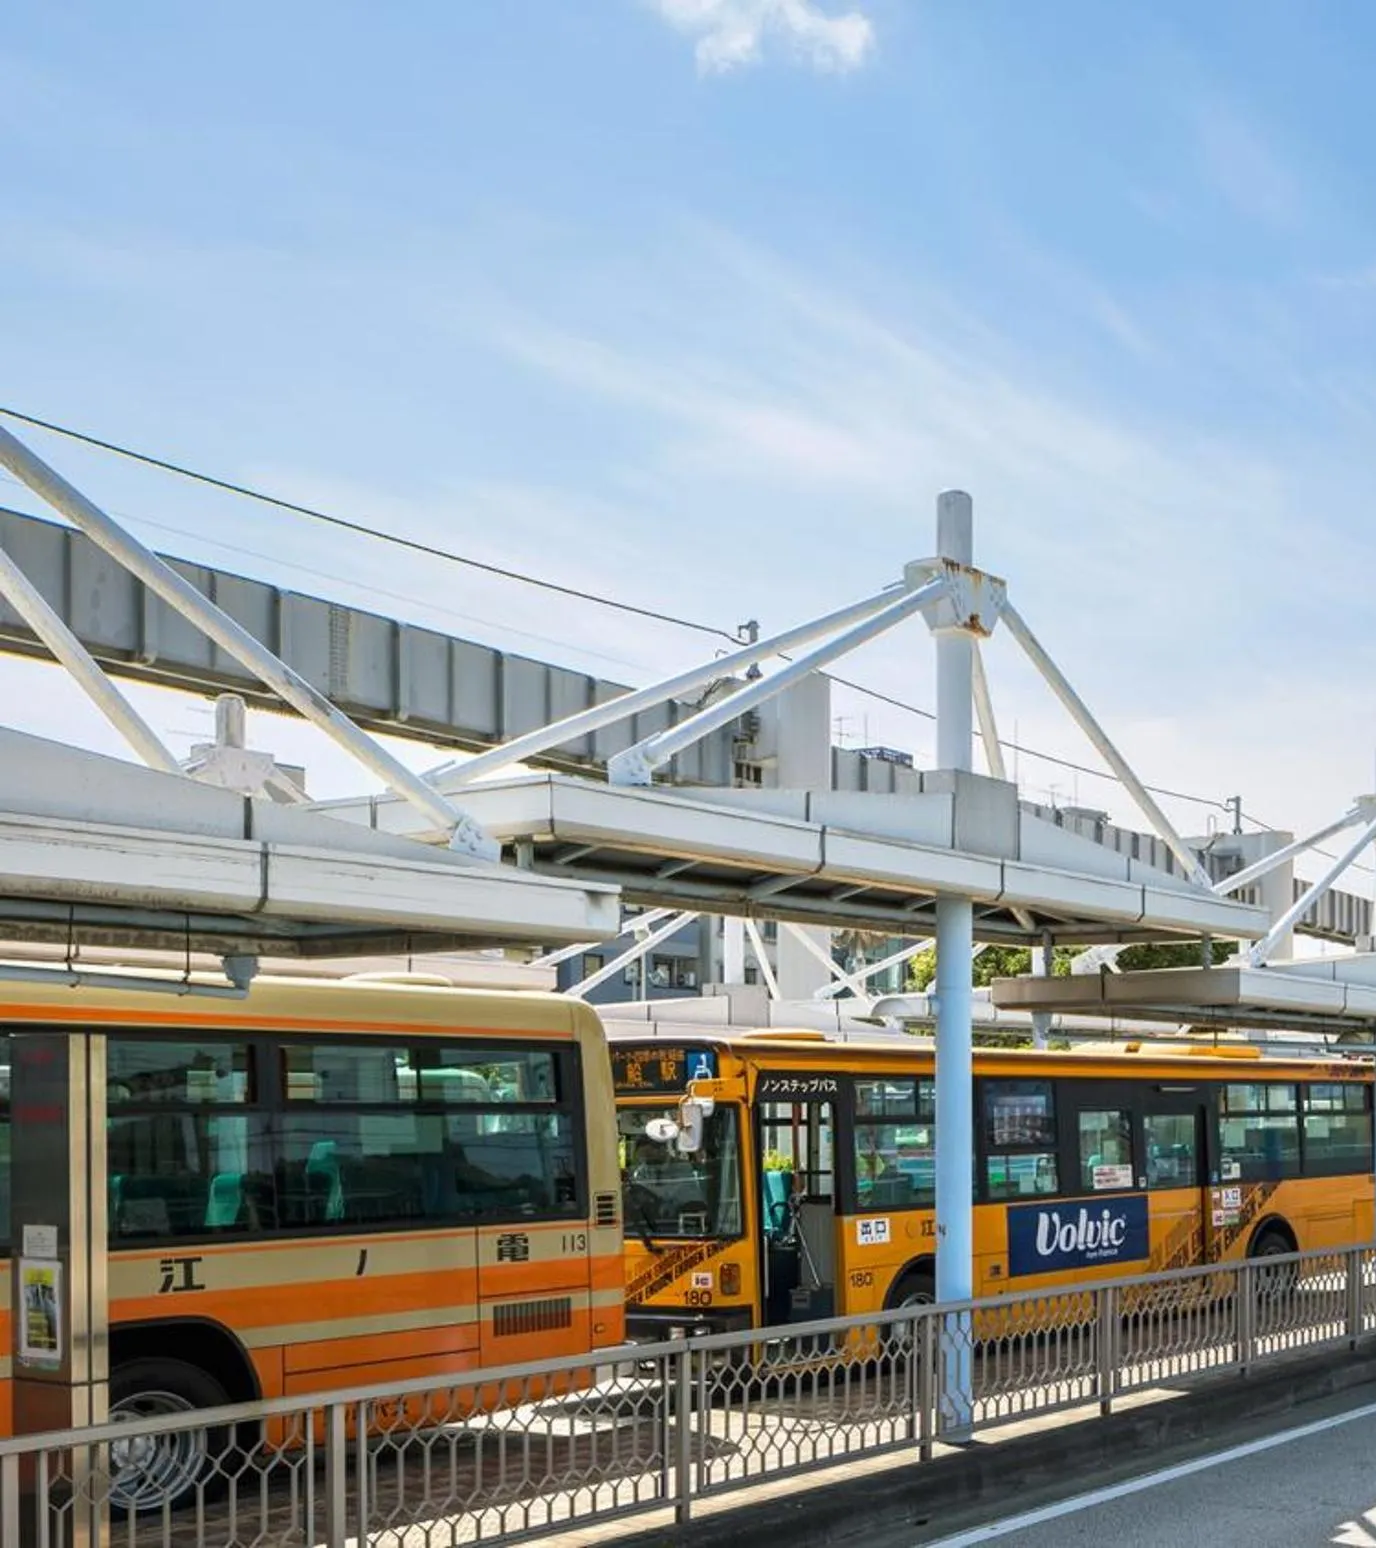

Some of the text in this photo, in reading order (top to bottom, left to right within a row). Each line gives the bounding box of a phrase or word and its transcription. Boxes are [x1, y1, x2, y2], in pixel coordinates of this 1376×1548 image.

[761, 1078, 838, 1093] ノンステップバス
[1036, 1208, 1126, 1256] Volvic
[561, 1235, 586, 1253] 113
[850, 1272, 873, 1288] 180
[684, 1290, 712, 1306] 180
